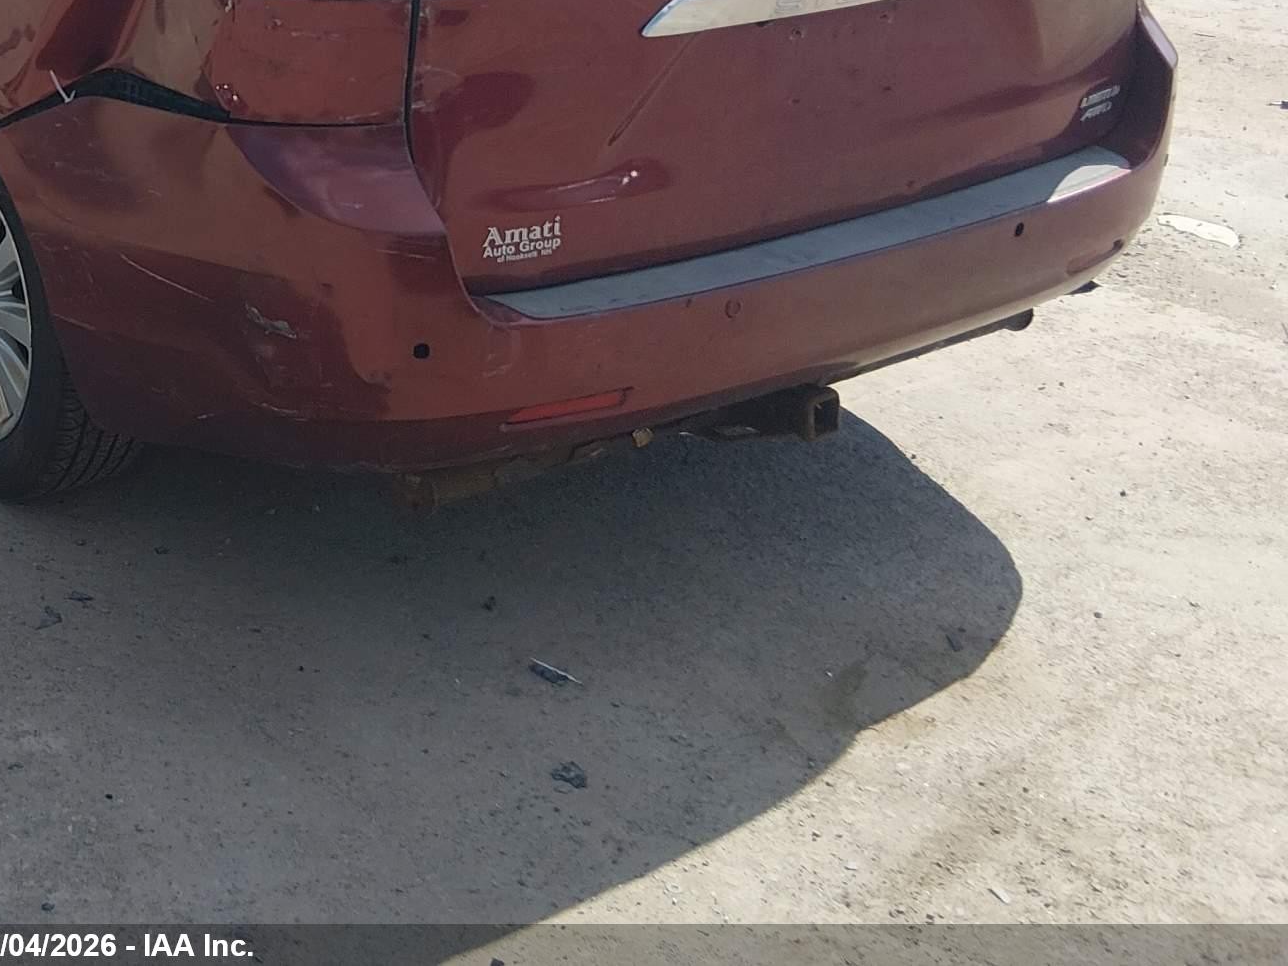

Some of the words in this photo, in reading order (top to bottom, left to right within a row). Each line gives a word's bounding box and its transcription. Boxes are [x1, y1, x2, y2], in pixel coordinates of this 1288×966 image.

[482, 215, 562, 247] Amati
[483, 245, 515, 258] Auto
[519, 238, 561, 252] Group
